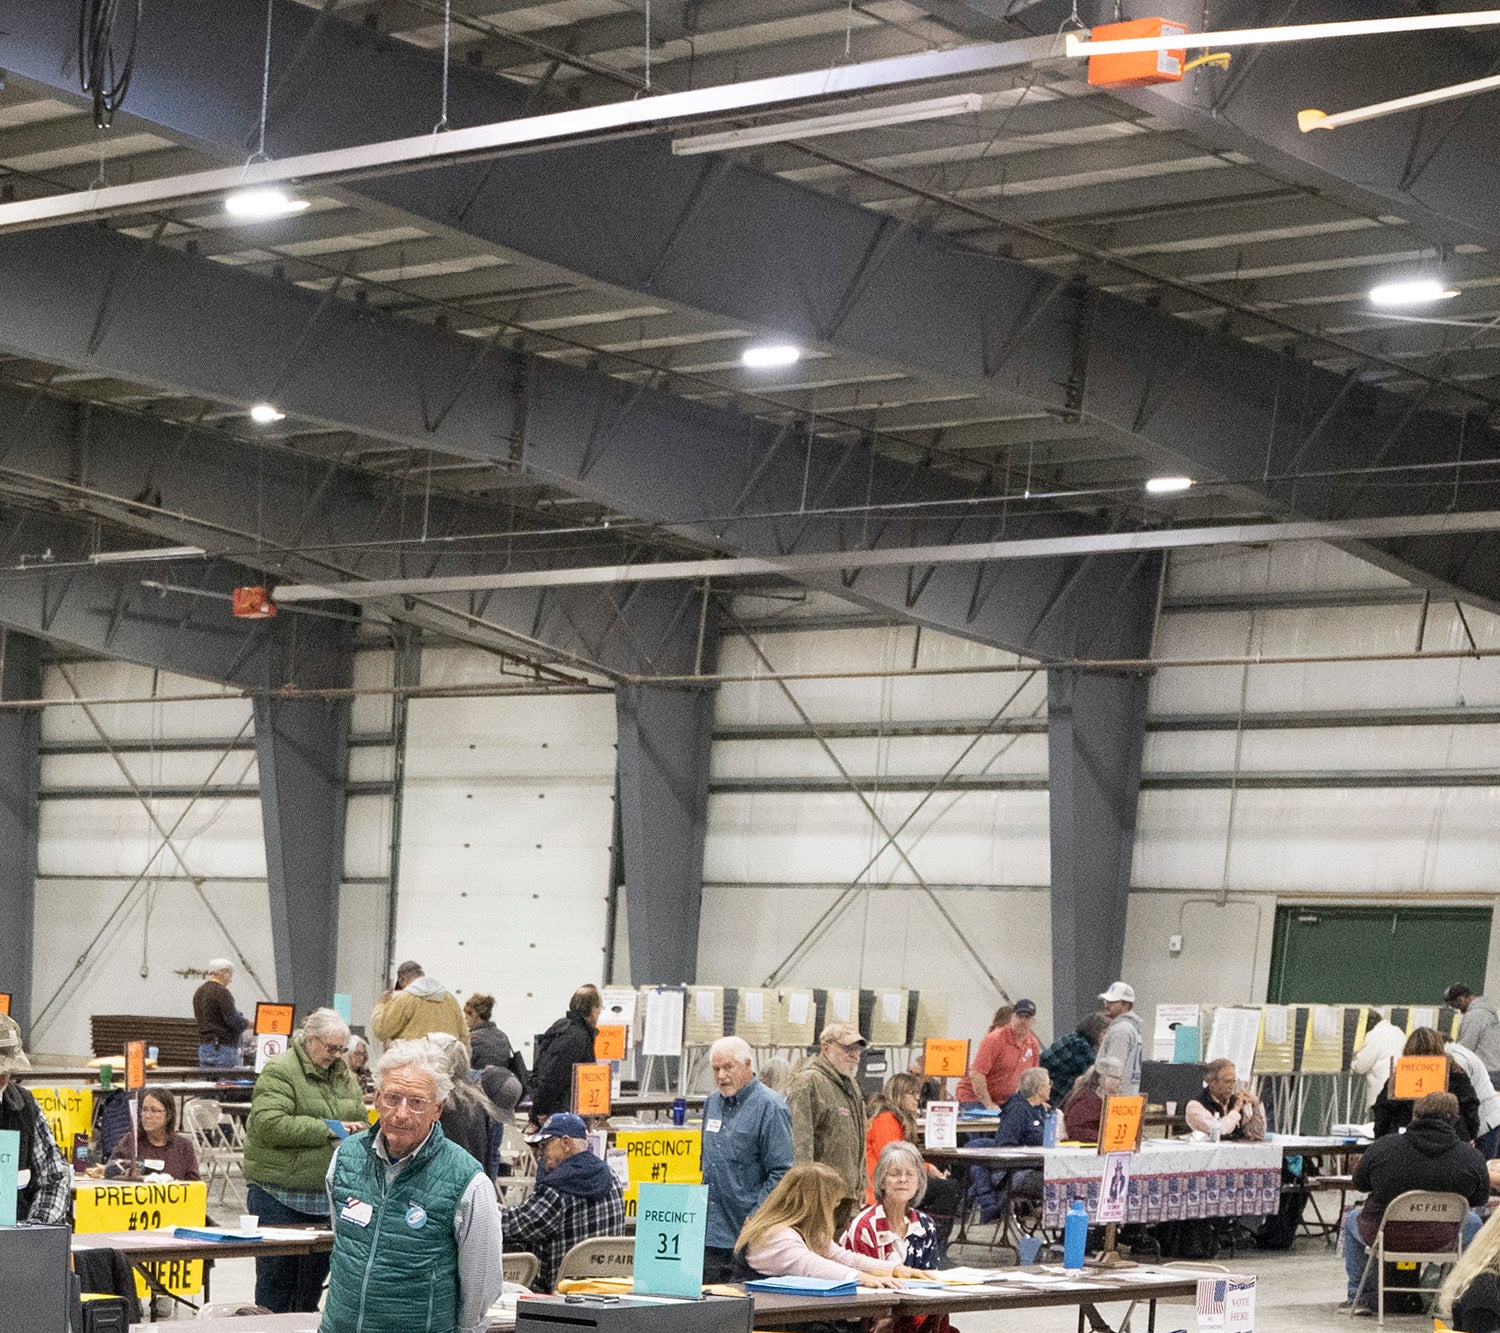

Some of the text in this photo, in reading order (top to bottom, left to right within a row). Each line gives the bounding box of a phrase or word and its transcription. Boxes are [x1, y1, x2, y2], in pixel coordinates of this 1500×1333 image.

[942, 1056, 949, 1067] 5
[1401, 1063, 1440, 1072] PRECINCT
[1415, 1077, 1423, 1089] 4
[39, 1097, 82, 1112] ECINCT
[627, 1140, 693, 1158] PRECINCT
[651, 1163, 668, 1182] #7
[95, 1184, 190, 1206] PRECINCT
[1425, 1204, 1448, 1213] FAIR
[644, 1210, 696, 1223] PRECINCT
[657, 1233, 679, 1254] 31
[590, 1254, 634, 1265] FC FAIR
